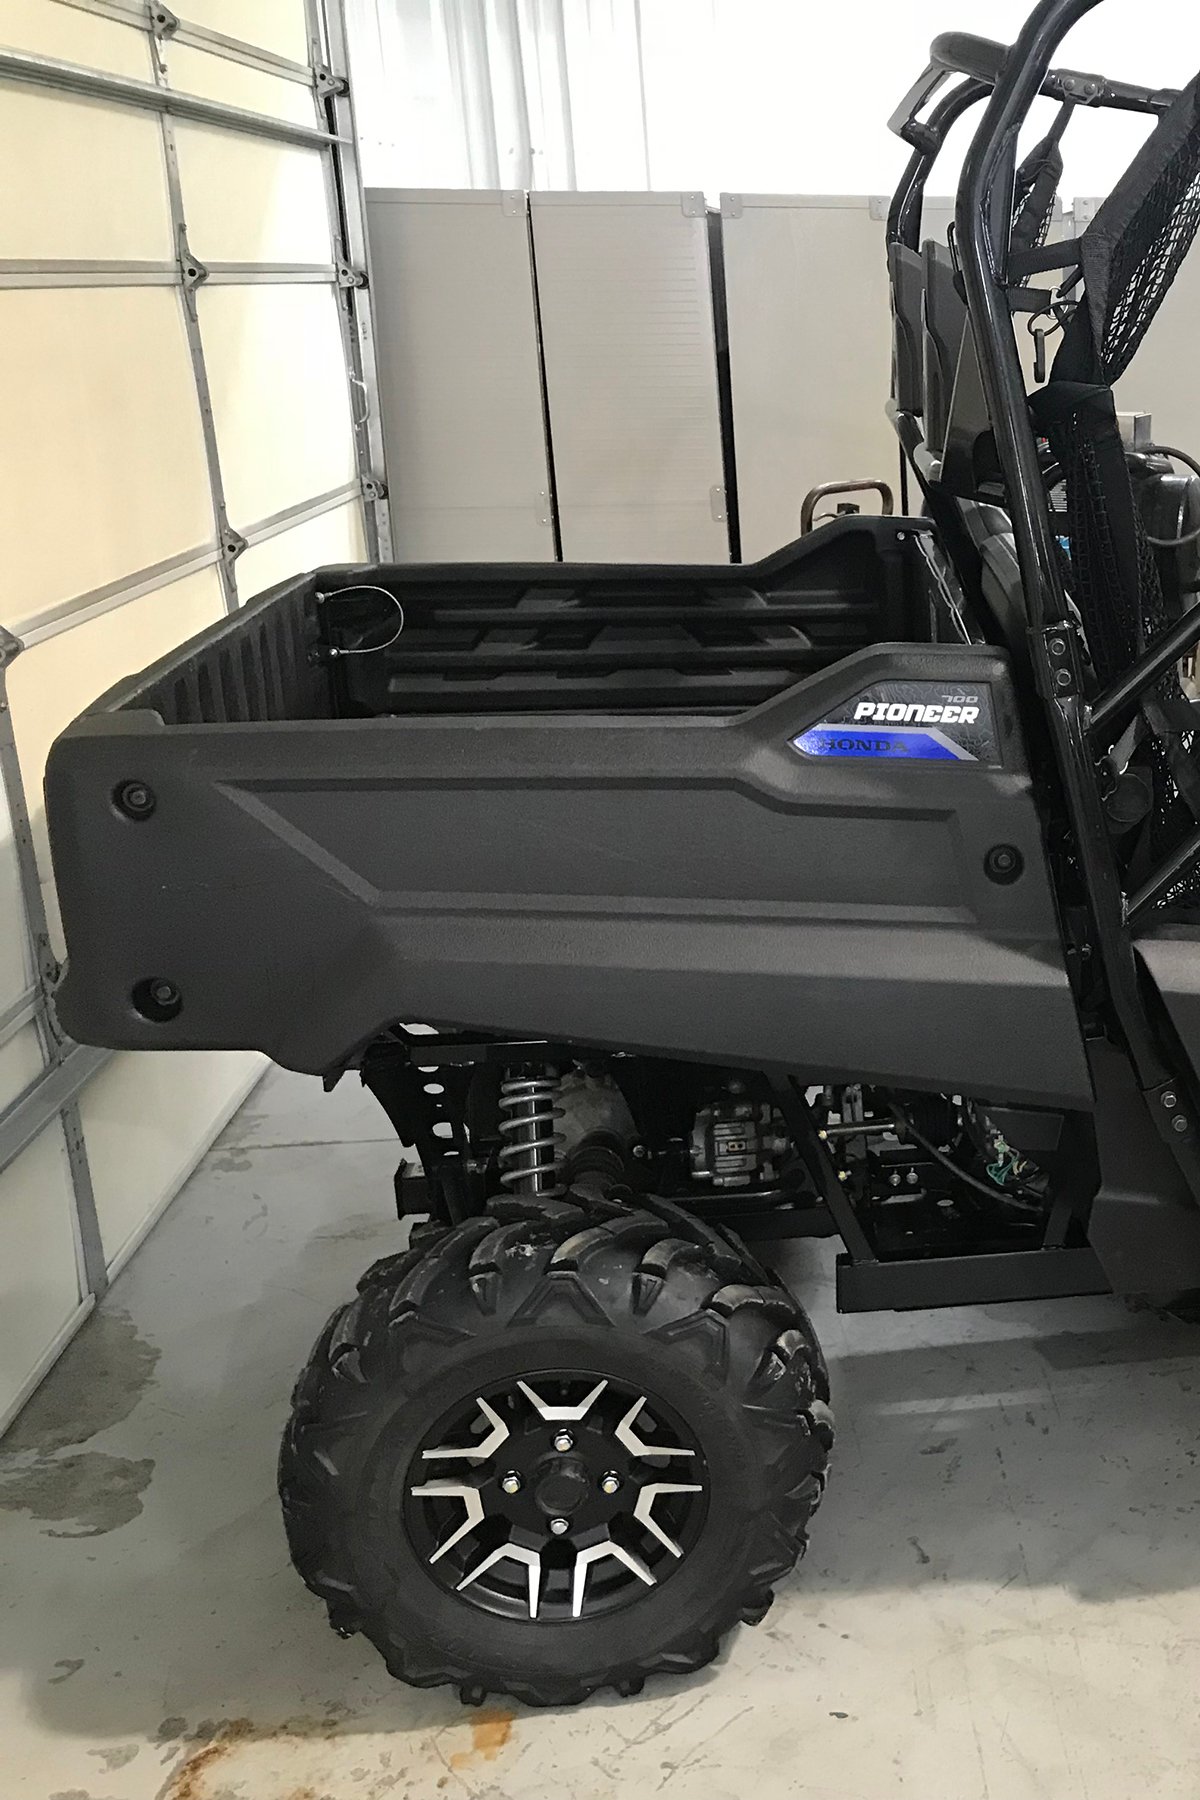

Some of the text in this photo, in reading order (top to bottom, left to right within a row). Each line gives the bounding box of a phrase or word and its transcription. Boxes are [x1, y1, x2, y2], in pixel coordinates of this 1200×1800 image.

[941, 694, 979, 704] 700
[853, 702, 980, 724] PIONEER
[821, 738, 909, 753] HONDA
